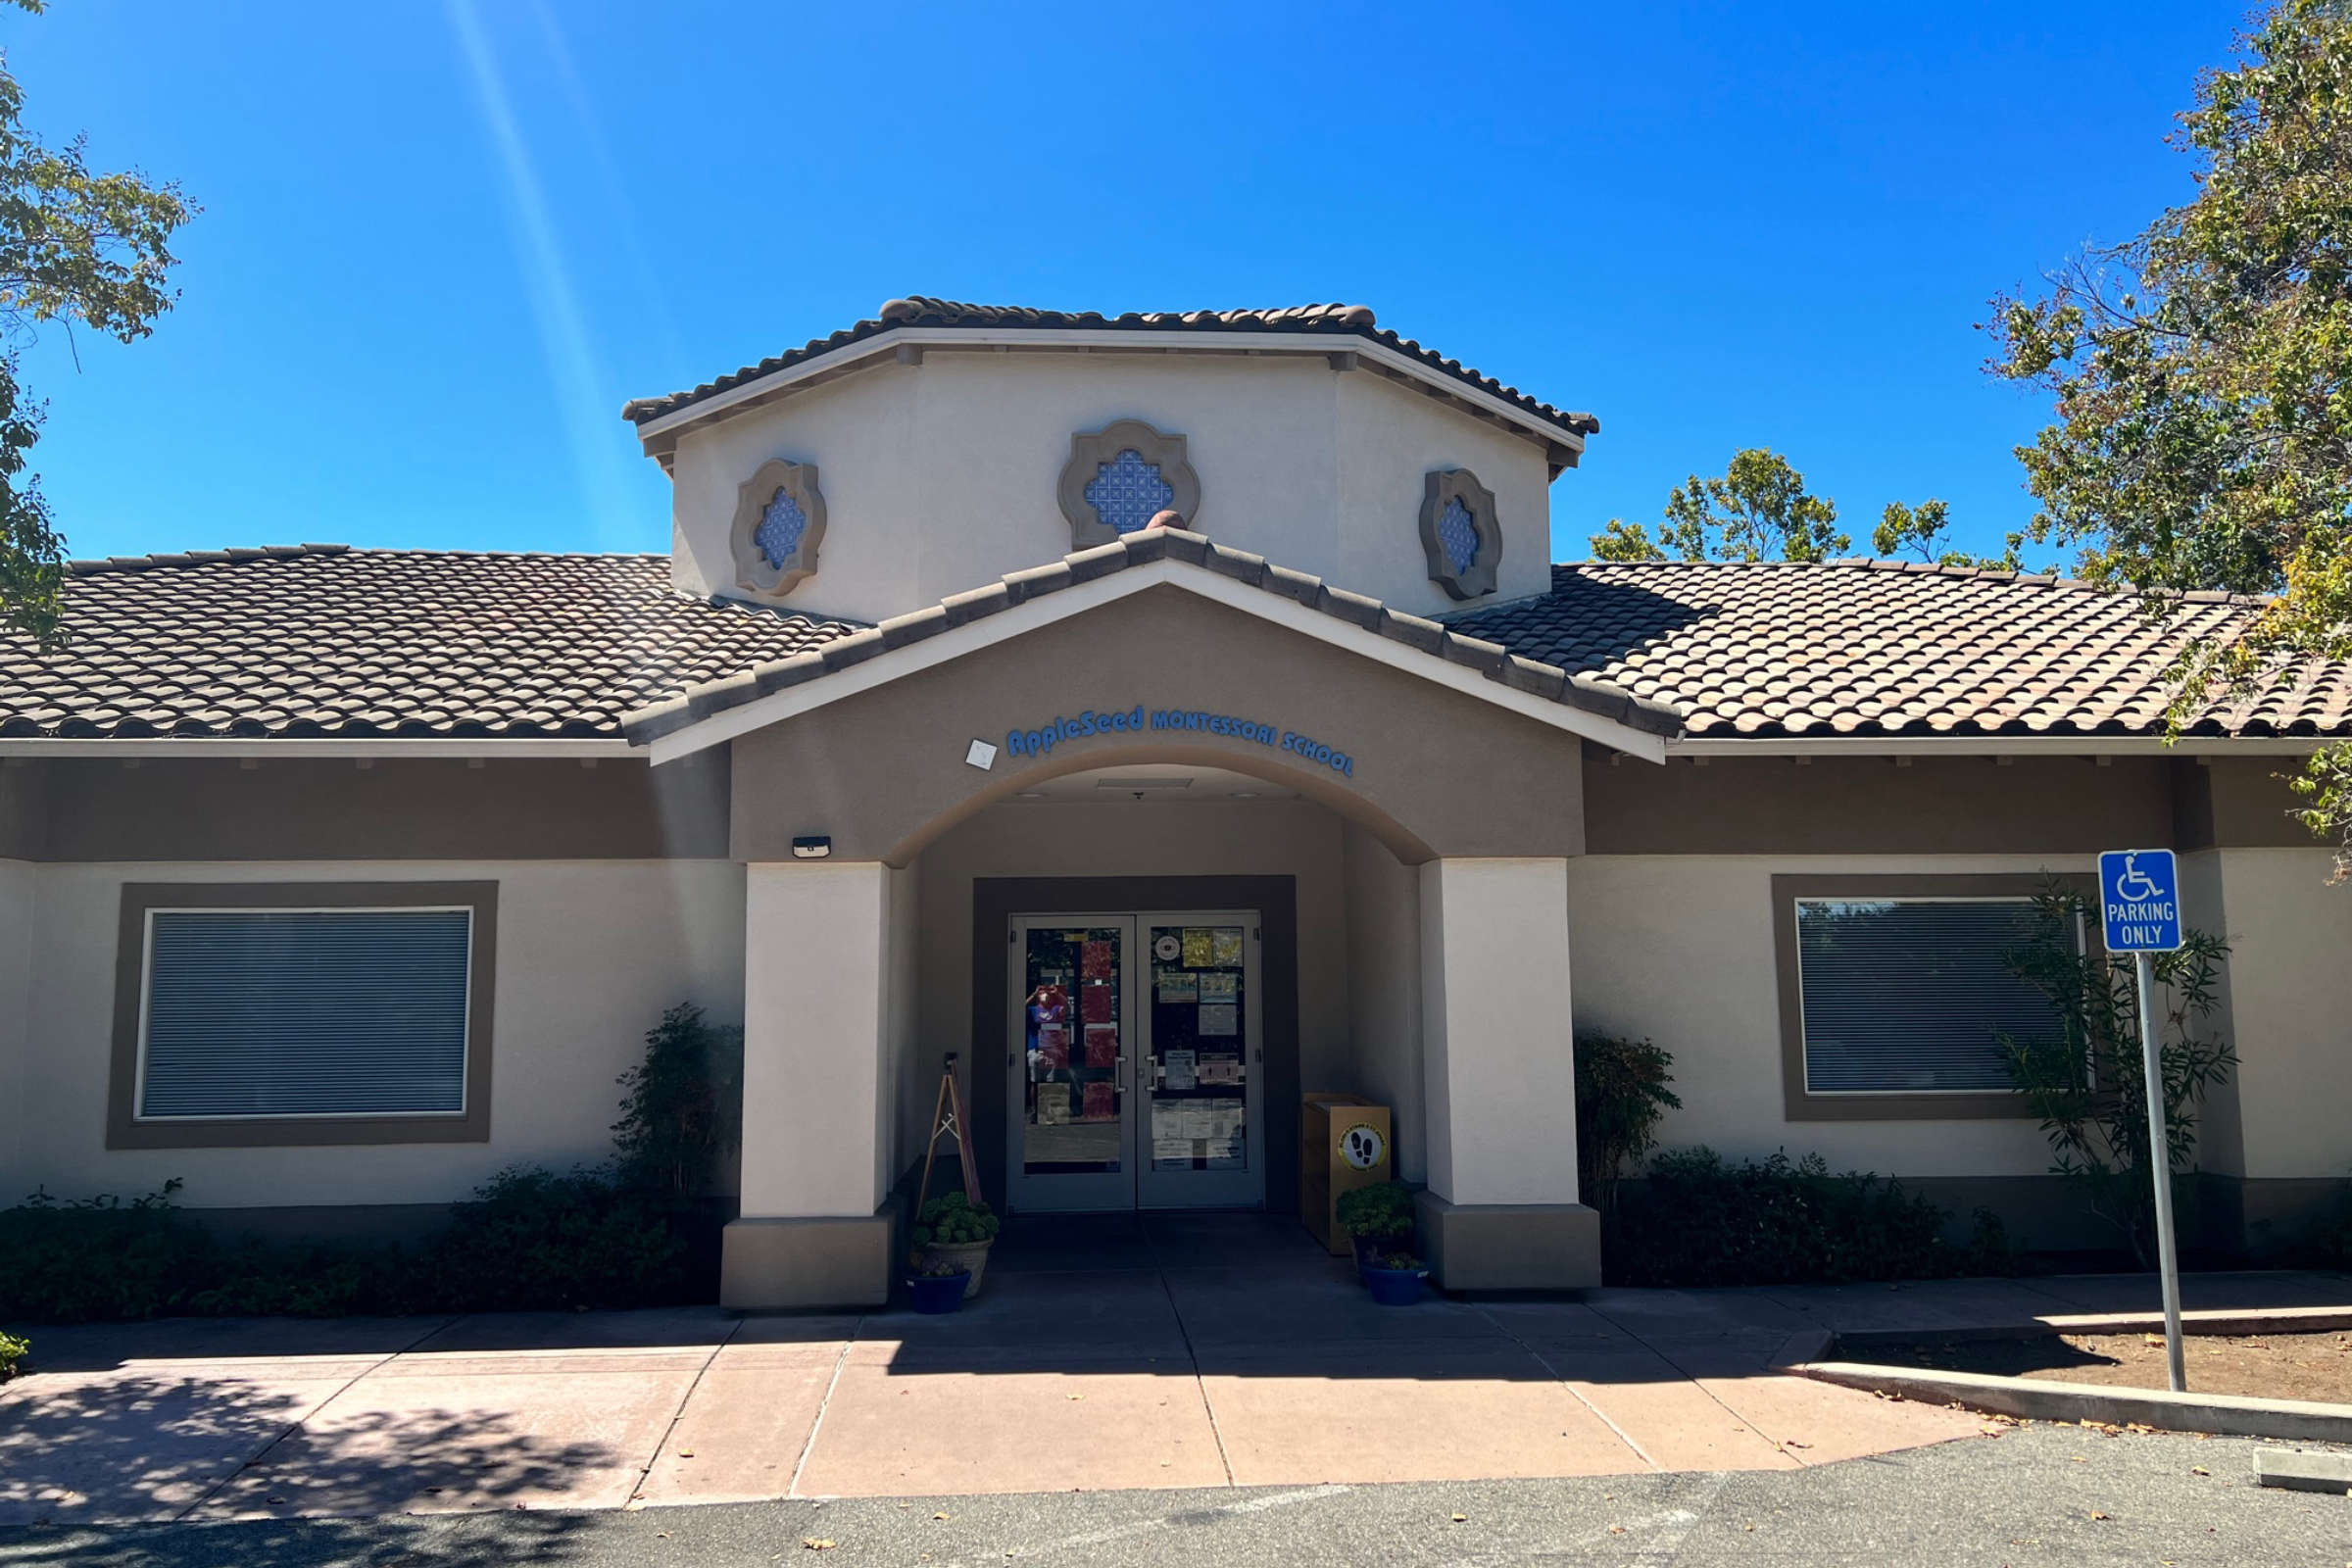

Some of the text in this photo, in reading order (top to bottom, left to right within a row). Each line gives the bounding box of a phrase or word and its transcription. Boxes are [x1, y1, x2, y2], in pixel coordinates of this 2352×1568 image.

[1007, 705, 1352, 777] AppleSeed MONTESSORI SCHOOL
[2108, 902, 2174, 922] PARKING
[2122, 925, 2162, 945] ONLY
